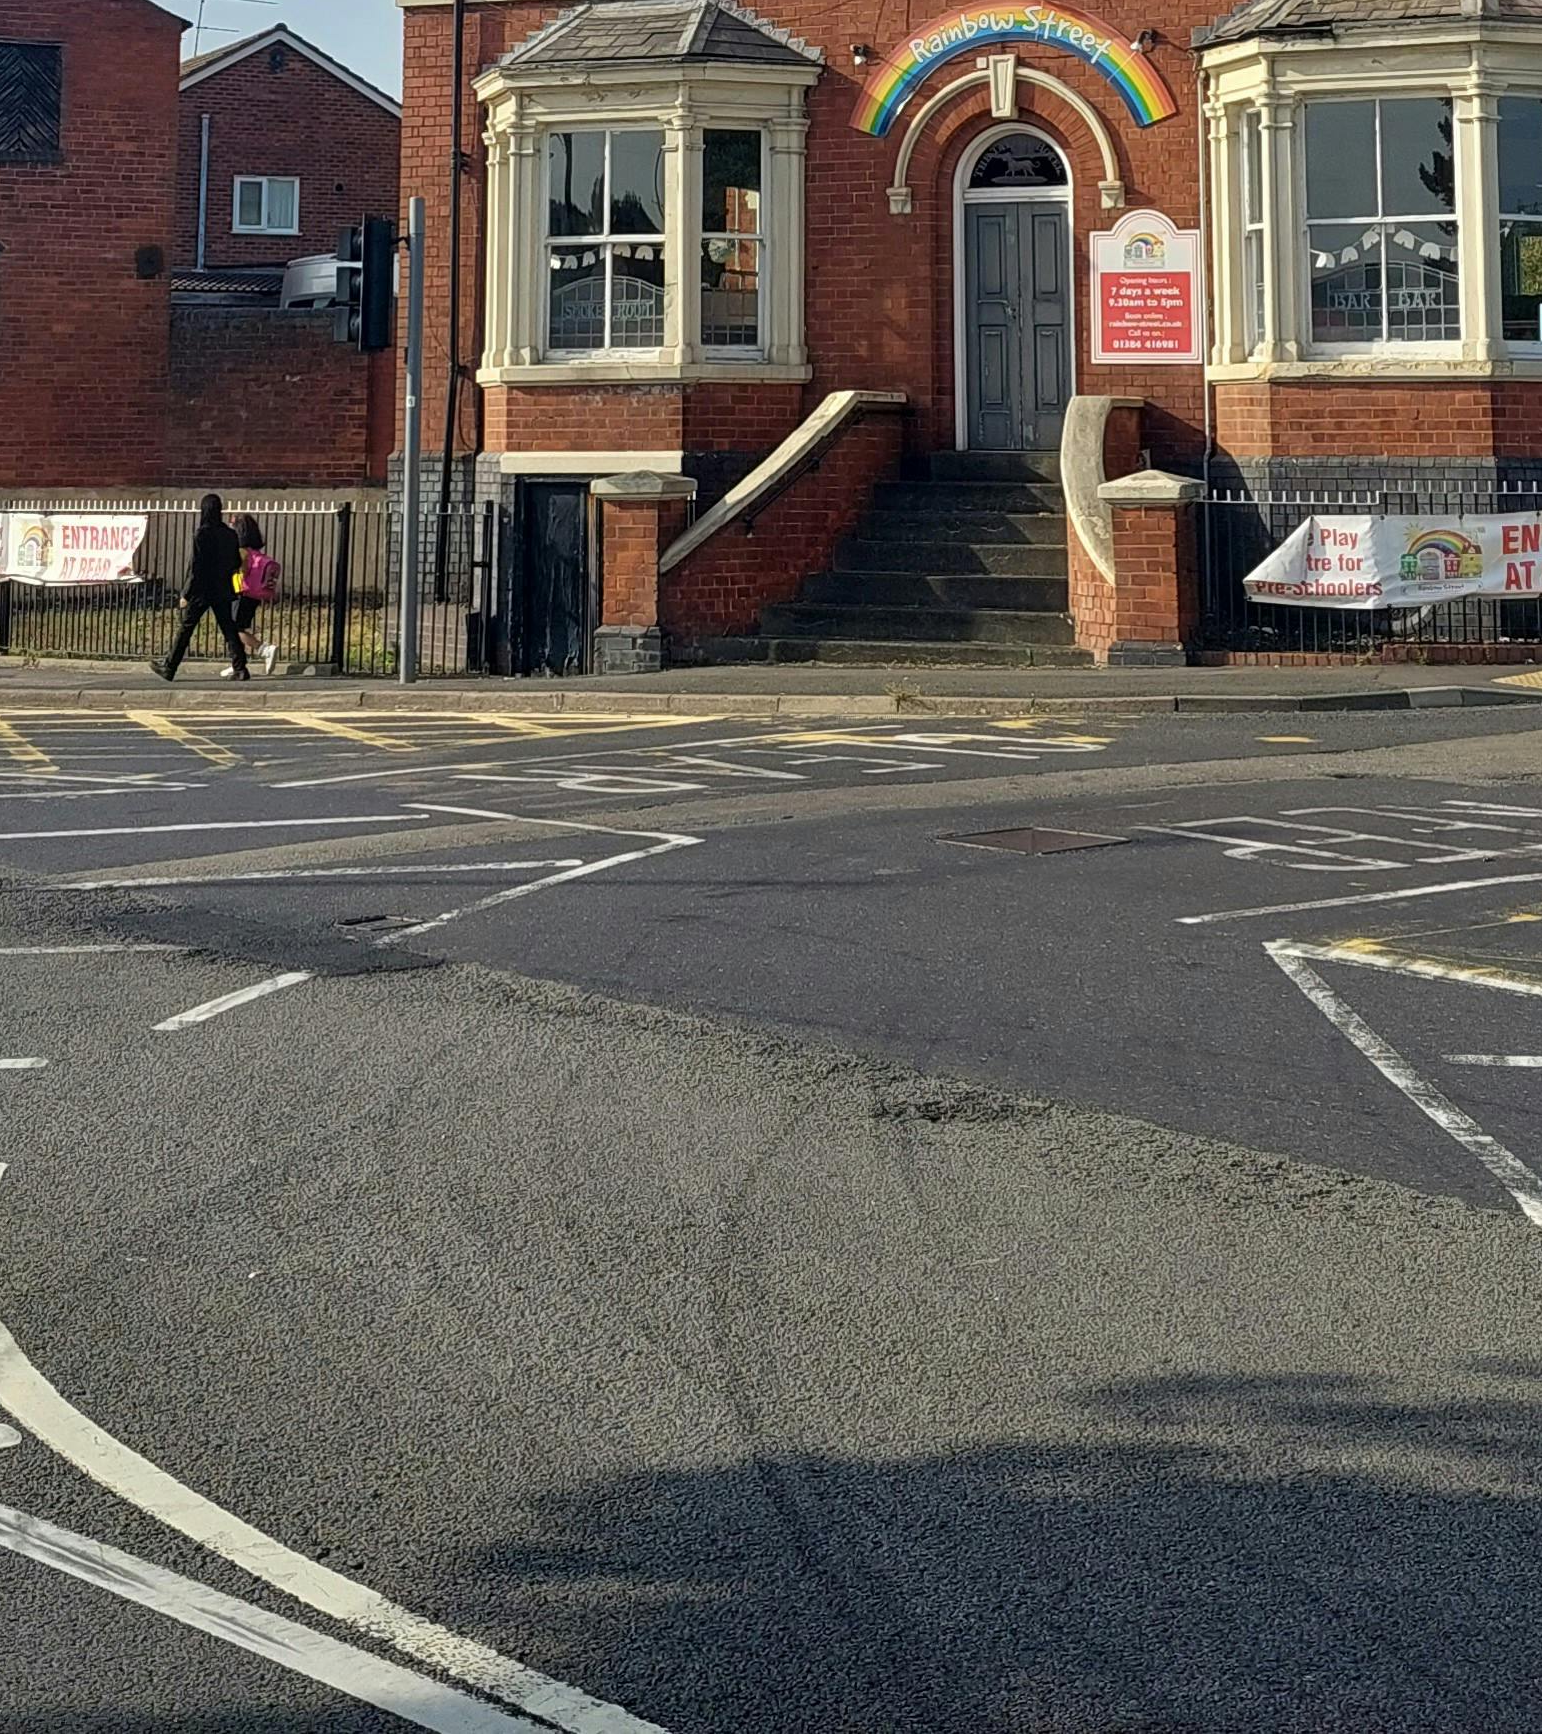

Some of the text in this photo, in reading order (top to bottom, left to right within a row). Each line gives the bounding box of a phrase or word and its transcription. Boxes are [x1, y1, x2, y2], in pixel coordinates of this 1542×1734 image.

[909, 5, 1112, 64] Rainbow Street
[1119, 276, 1147, 285] Opening
[1110, 286, 1117, 296] 7
[1119, 286, 1142, 297] days
[1152, 286, 1180, 295] week
[1334, 292, 1437, 309] BAR BAR
[1108, 297, 1183, 309] 9.30am to 5pm
[1113, 339, 1178, 348] 01384 416981
[62, 525, 140, 551] ENTRANCE
[1320, 529, 1358, 549] Play
[60, 557, 111, 579] AT REAR
[1338, 553, 1364, 572] for
[1505, 560, 1536, 590] AT
[1255, 578, 1383, 597] Pre-Schoolers
